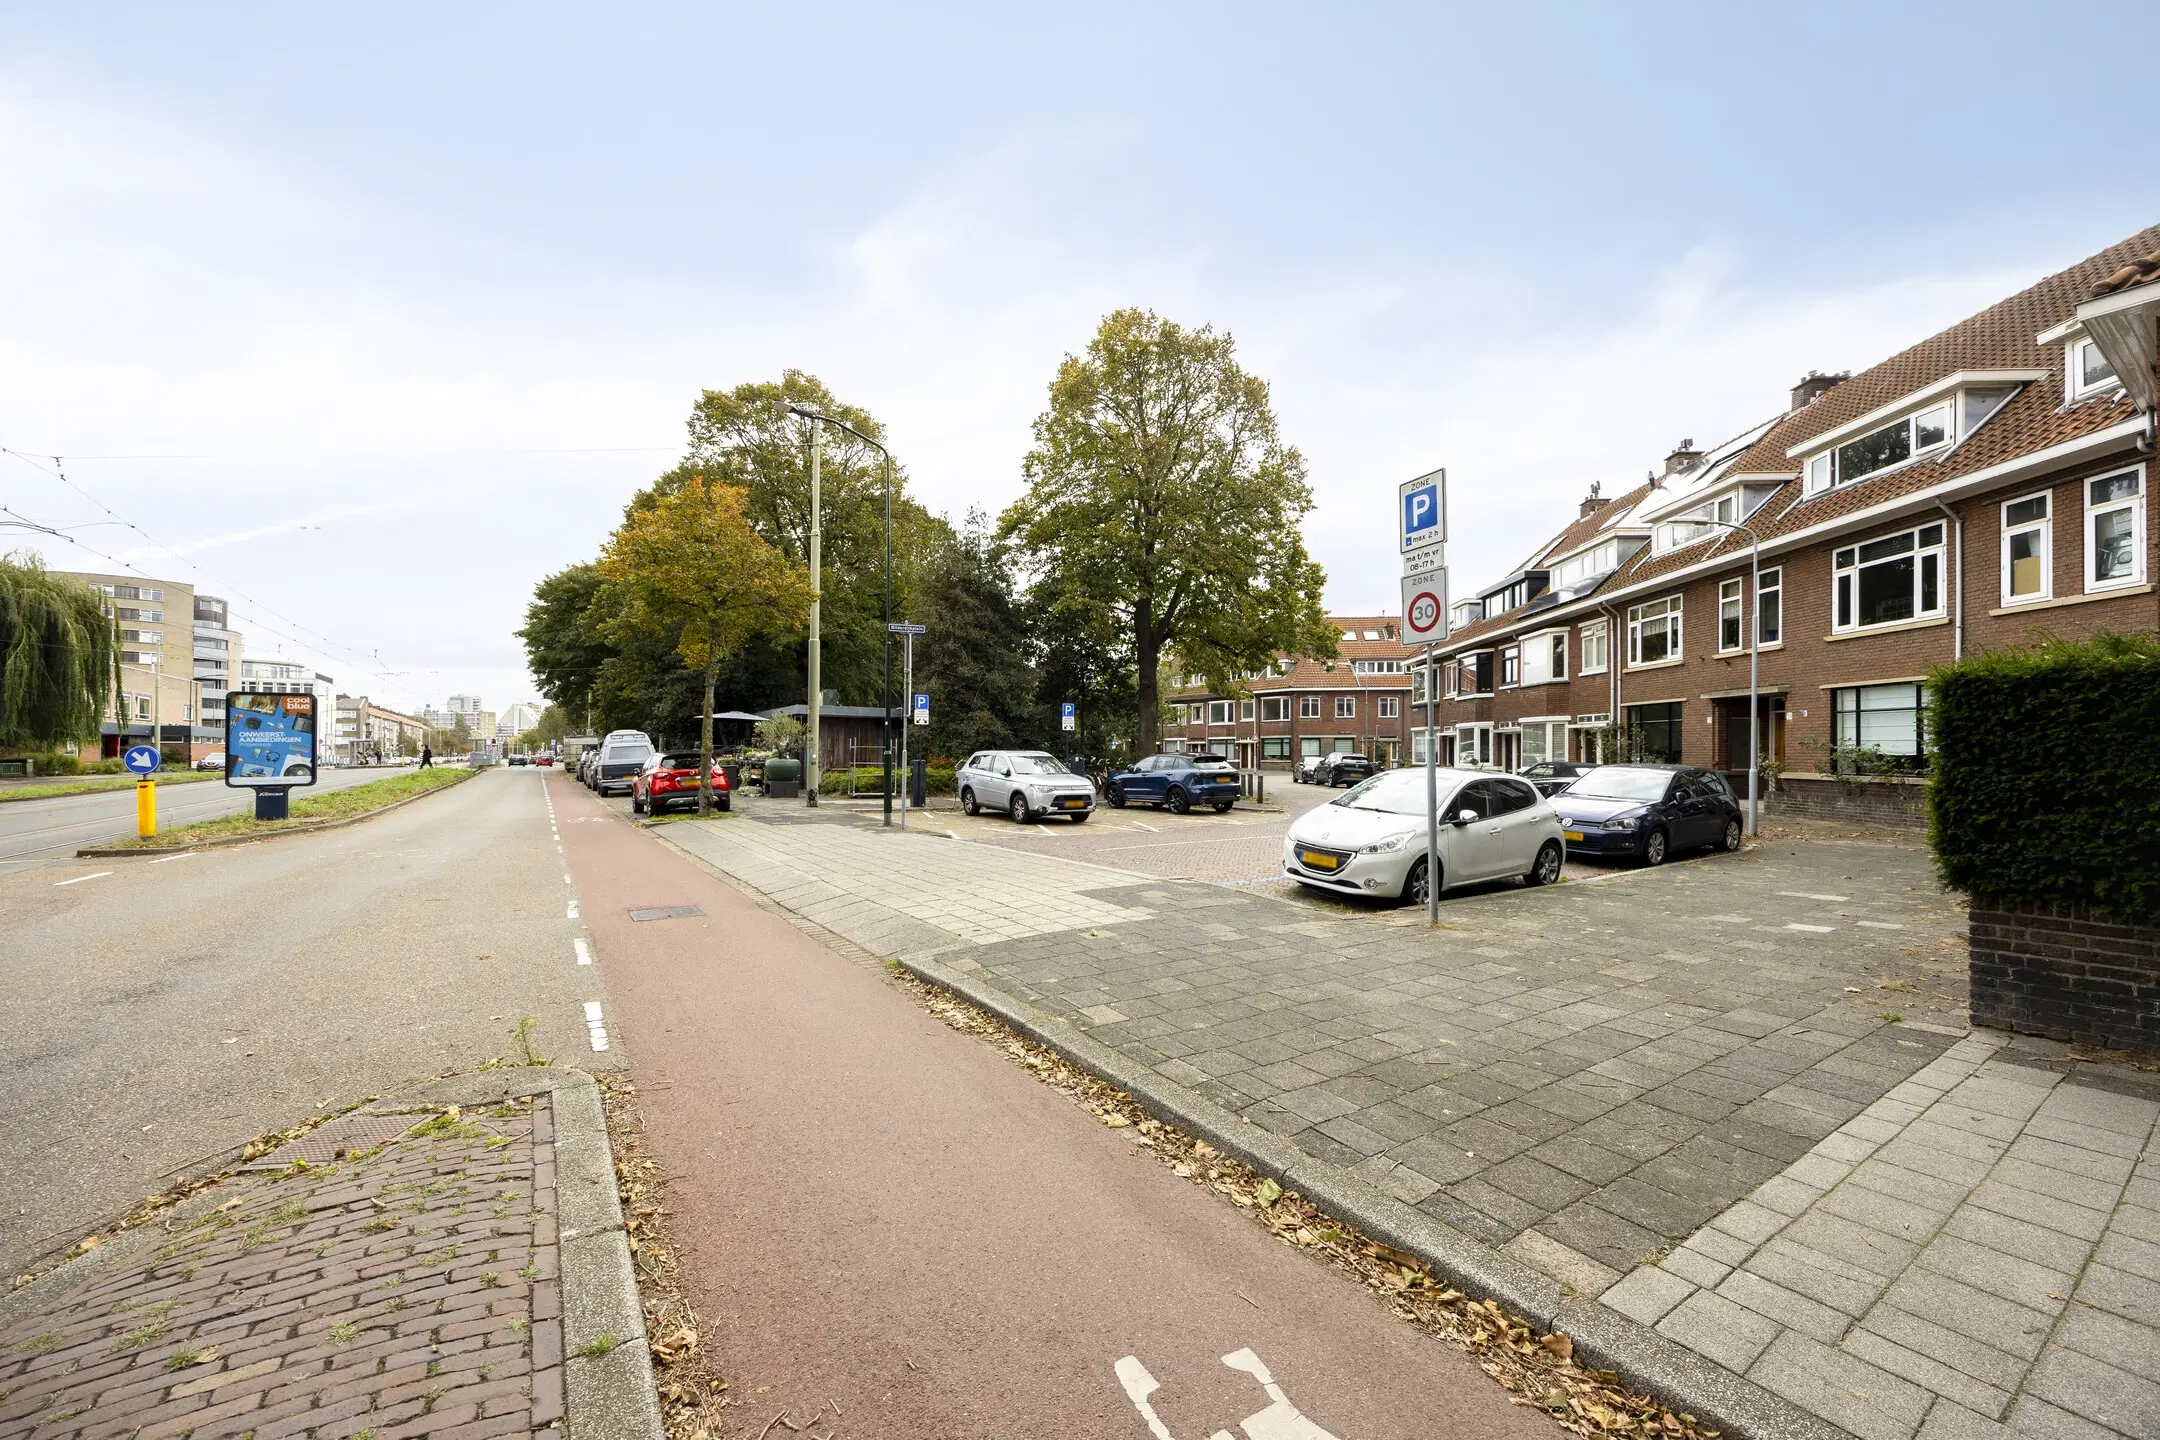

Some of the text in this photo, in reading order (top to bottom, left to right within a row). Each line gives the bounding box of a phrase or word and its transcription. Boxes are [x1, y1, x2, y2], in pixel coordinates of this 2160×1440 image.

[1411, 478, 1430, 491] ZONE
[1412, 494, 1430, 527] P
[1413, 534, 1426, 543] max
[1417, 552, 1430, 560] t/m
[1410, 561, 1428, 571] 08-17
[1412, 574, 1435, 586] ZONE
[1414, 603, 1435, 620] 30
[918, 696, 926, 708] P
[1065, 705, 1072, 715] P
